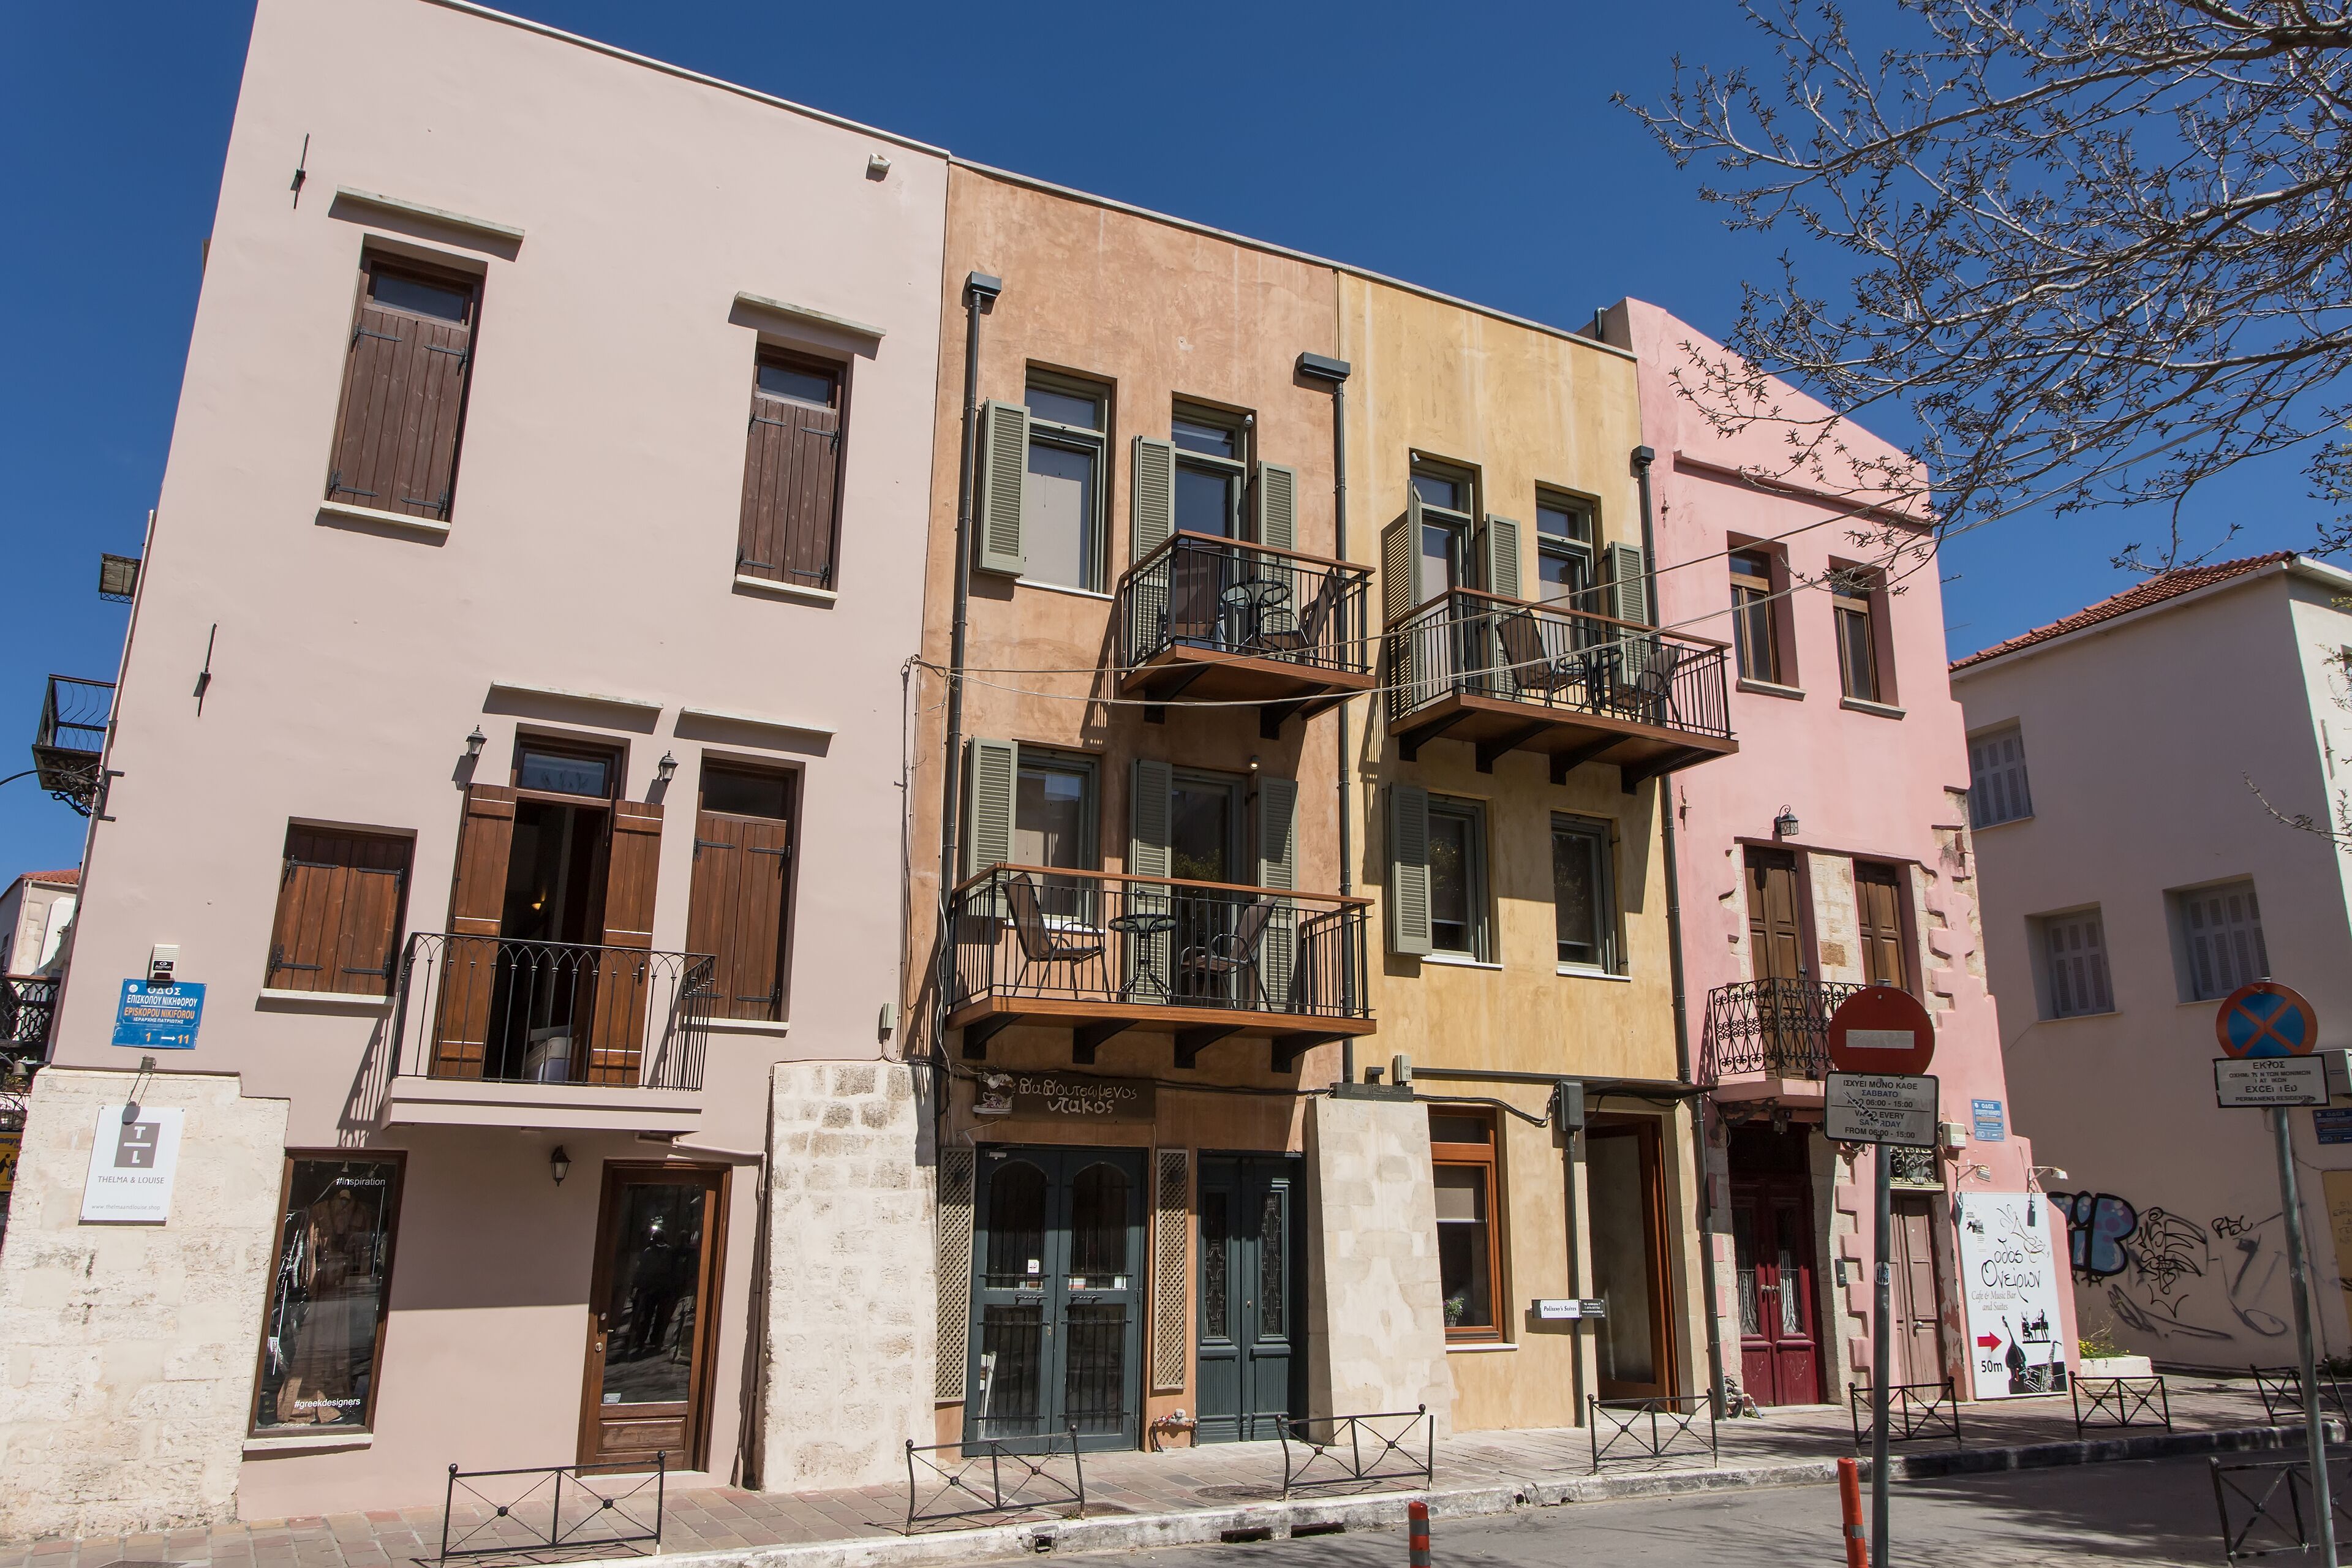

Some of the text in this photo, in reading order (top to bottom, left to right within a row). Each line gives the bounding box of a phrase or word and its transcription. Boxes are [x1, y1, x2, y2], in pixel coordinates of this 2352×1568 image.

[148, 987, 181, 995] ΟΔΟΣ
[127, 995, 198, 1007] ΕΠΙΣΚΟΠΟΥ ΝΙΚΗΦΟΡΟΥ
[124, 1007, 195, 1019] EPISKOPOU NIKIFOROU
[146, 1032, 151, 1042] 1
[178, 1035, 189, 1044] 11
[134, 1126, 146, 1139] T
[132, 1151, 140, 1163] L
[336, 1177, 386, 1187] #inspiration
[1971, 1290, 2017, 1303] Cafe & Music Bar
[1982, 1302, 1992, 1311] and
[1981, 1360, 2003, 1373] 50m
[294, 1398, 361, 1409] #greekdesigners
